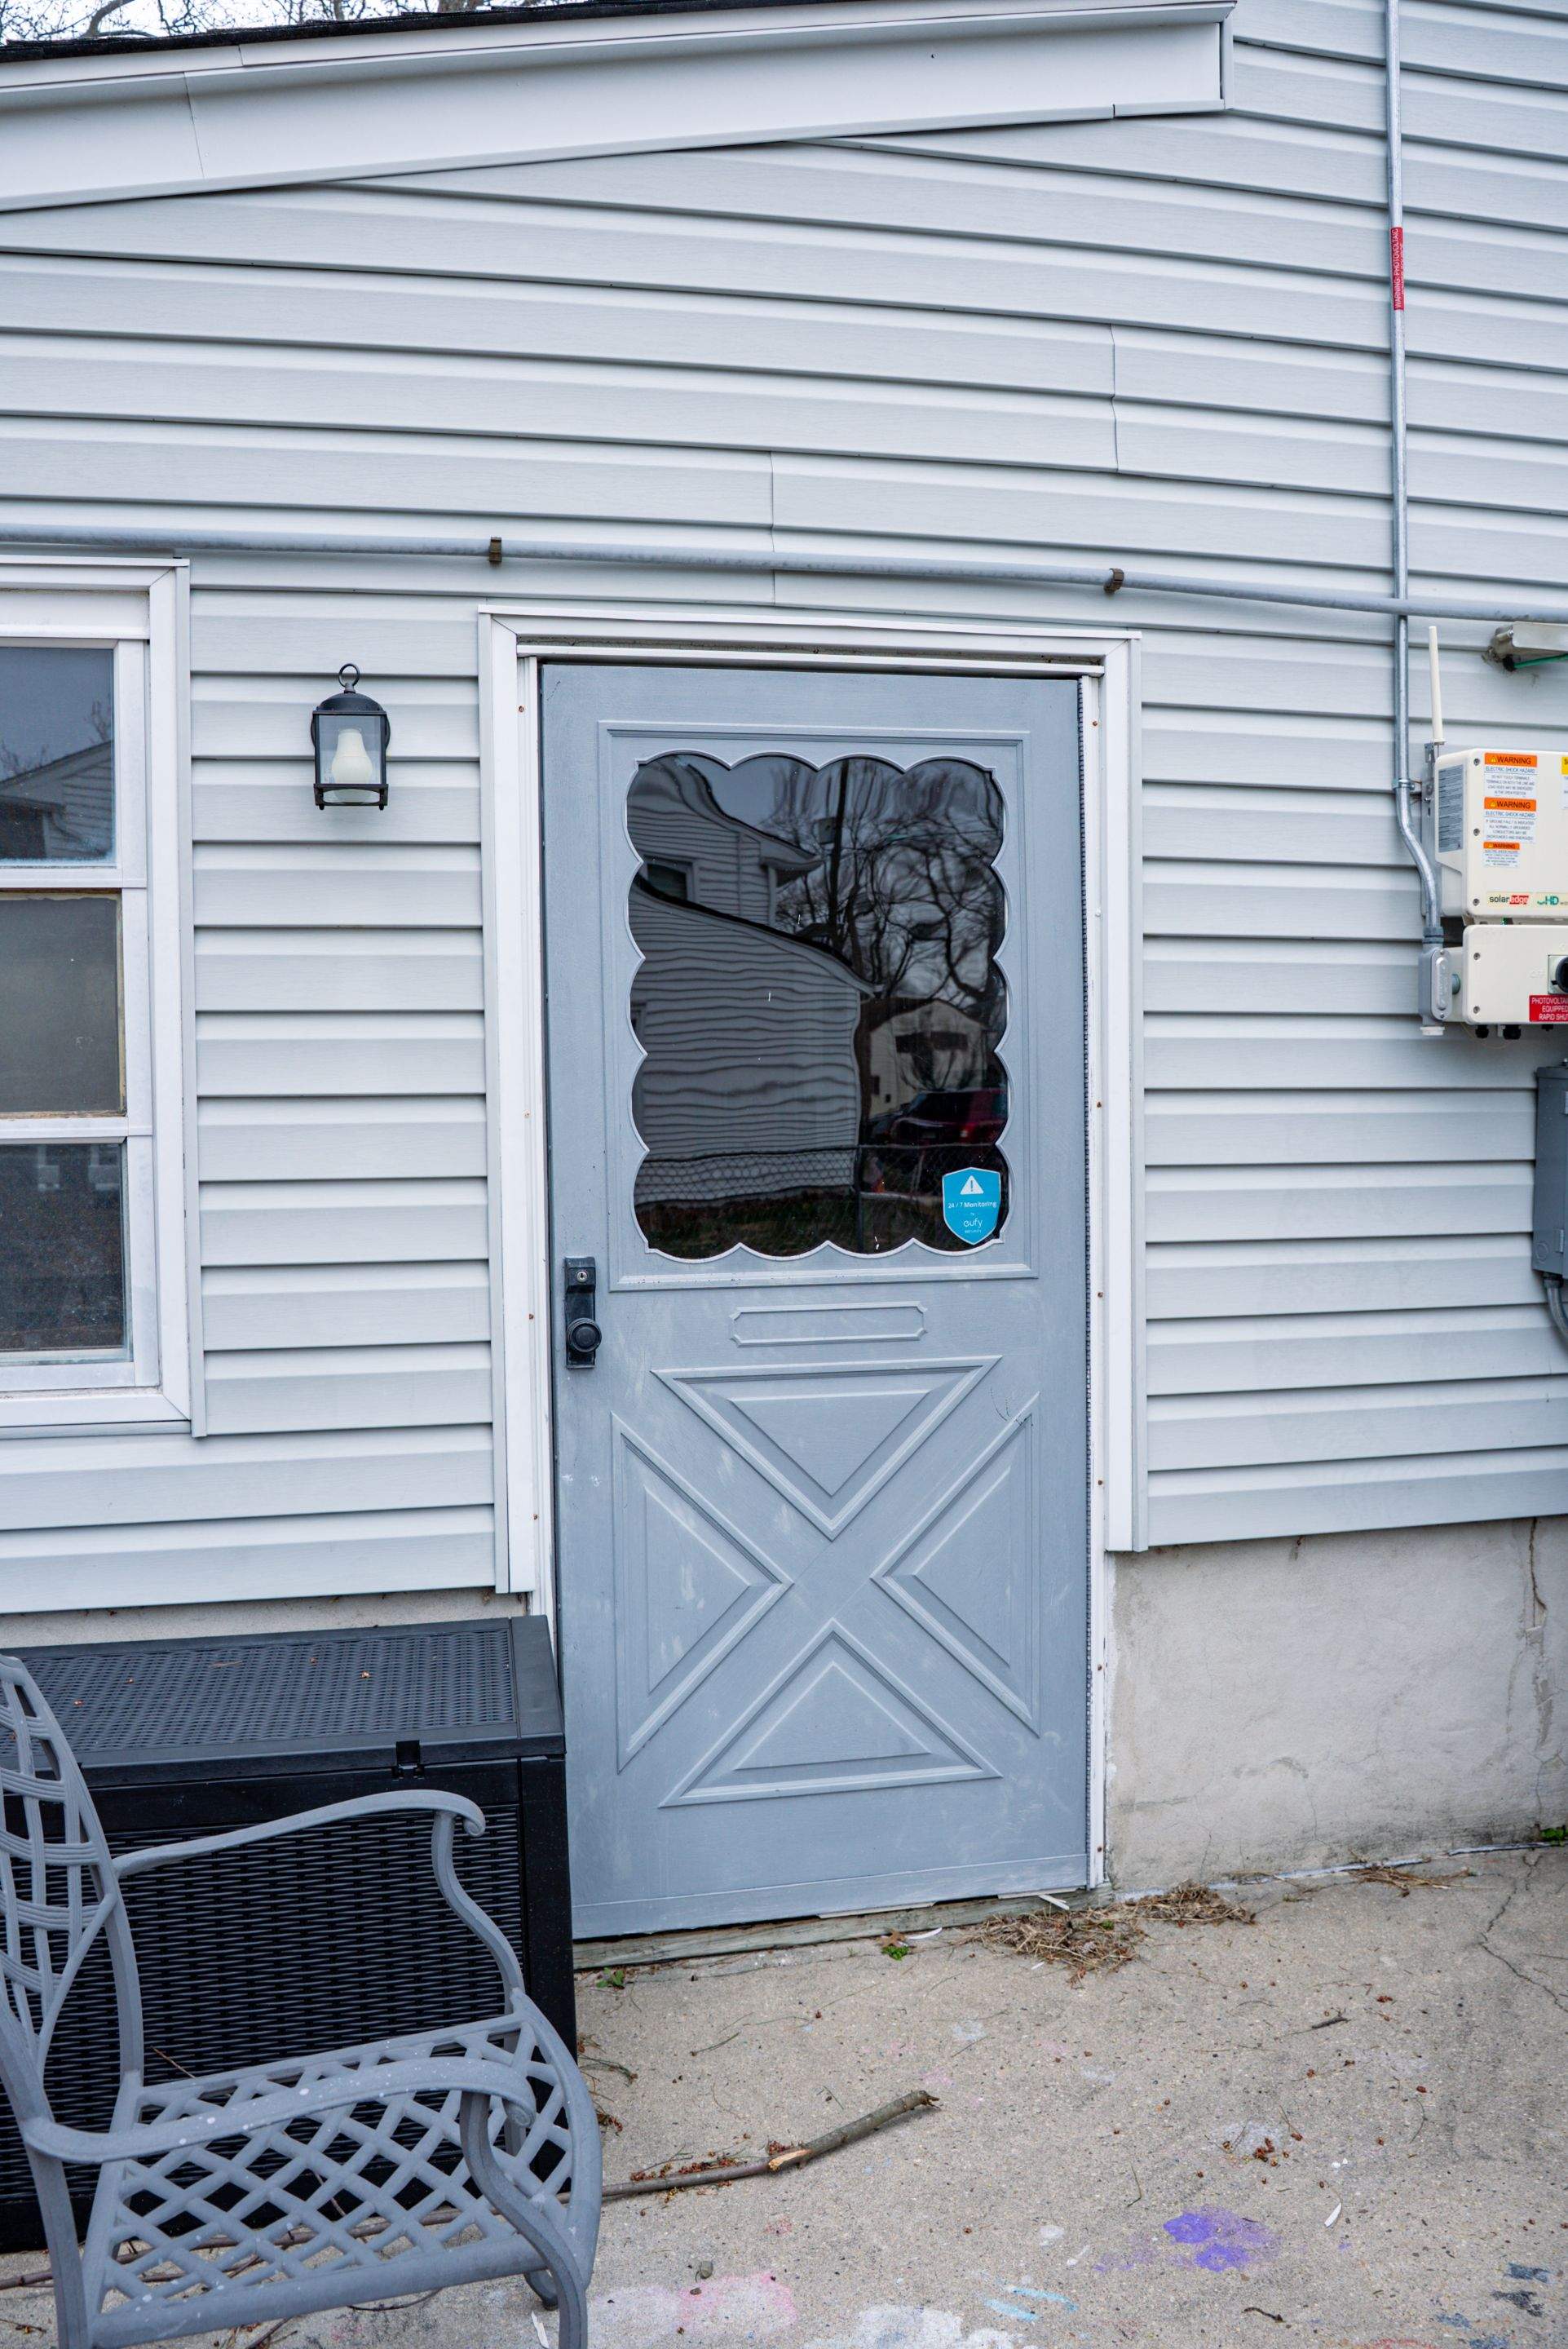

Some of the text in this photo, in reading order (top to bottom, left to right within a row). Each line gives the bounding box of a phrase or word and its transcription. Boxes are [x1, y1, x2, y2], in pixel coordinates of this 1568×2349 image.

[1392, 229, 1400, 276] PHOTOVOLTAIC
[1497, 756, 1531, 764] WARNING
[1496, 801, 1531, 809] WARNING
[1545, 896, 1559, 905] HD
[1542, 1005, 1568, 1013] EQUIPPED
[963, 1218, 983, 1228] eufy
